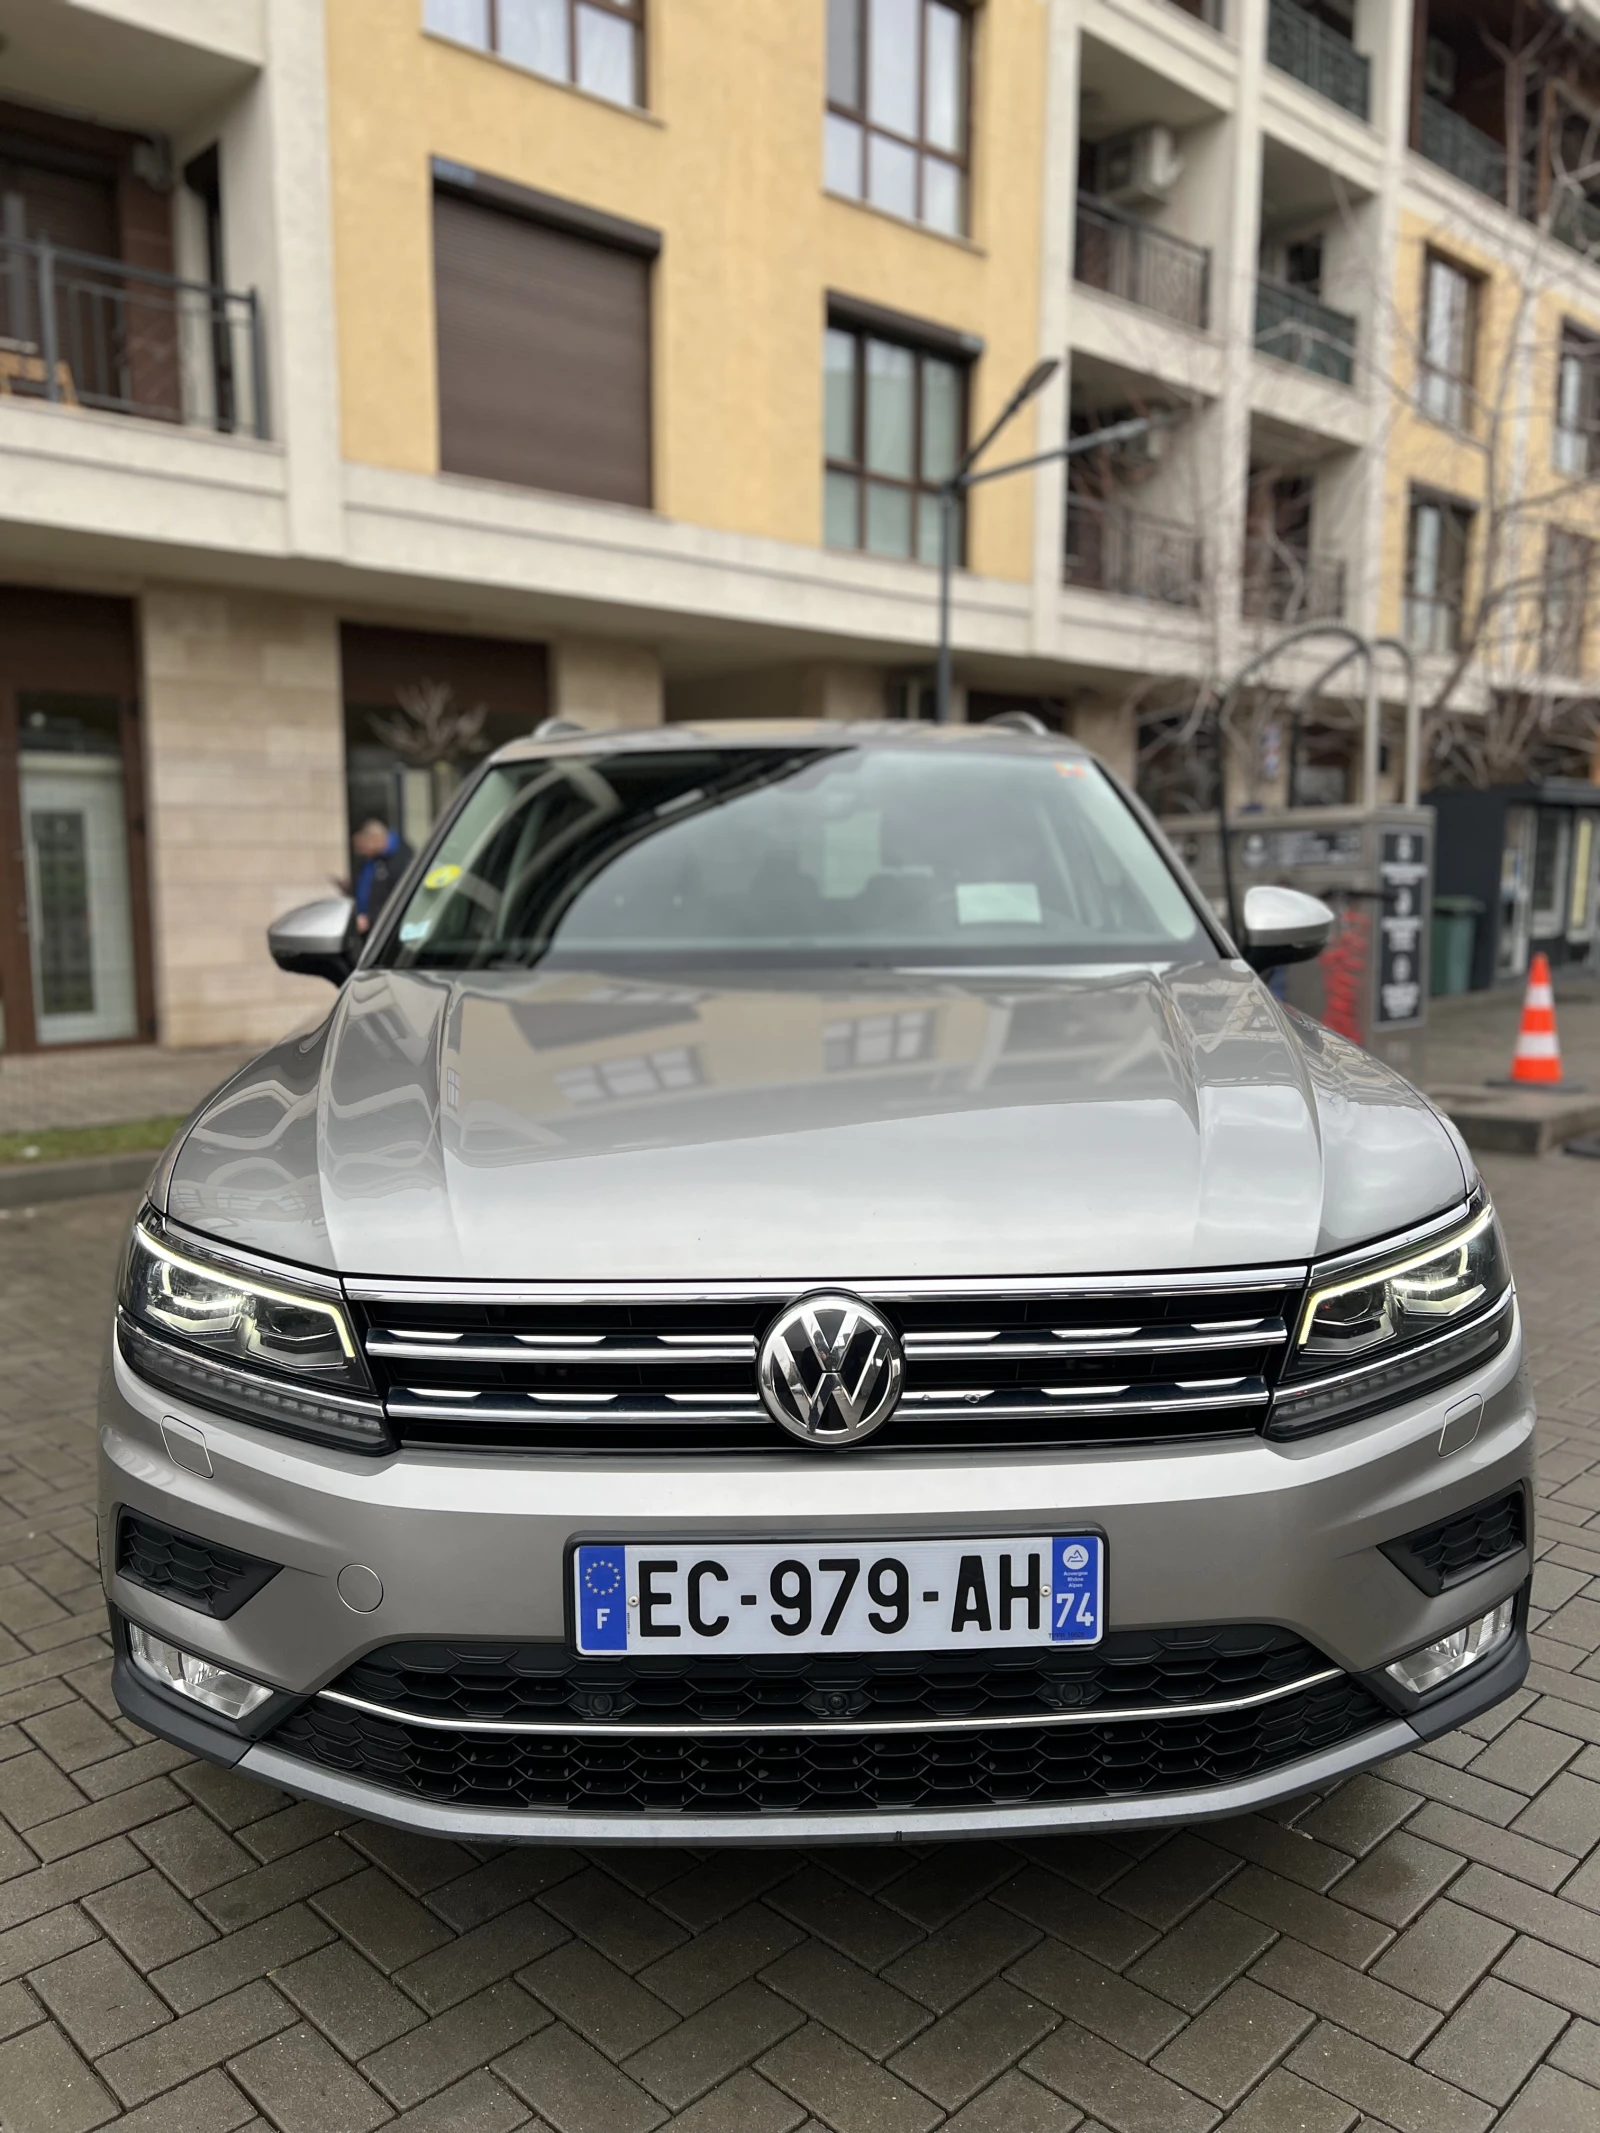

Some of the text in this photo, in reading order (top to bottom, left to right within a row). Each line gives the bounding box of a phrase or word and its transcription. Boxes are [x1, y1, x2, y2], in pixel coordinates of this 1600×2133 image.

[766, 1303, 898, 1437] VW
[596, 1608, 610, 1630] F
[638, 1553, 1041, 1637] EC-979-AH
[1056, 1592, 1094, 1628] 74
